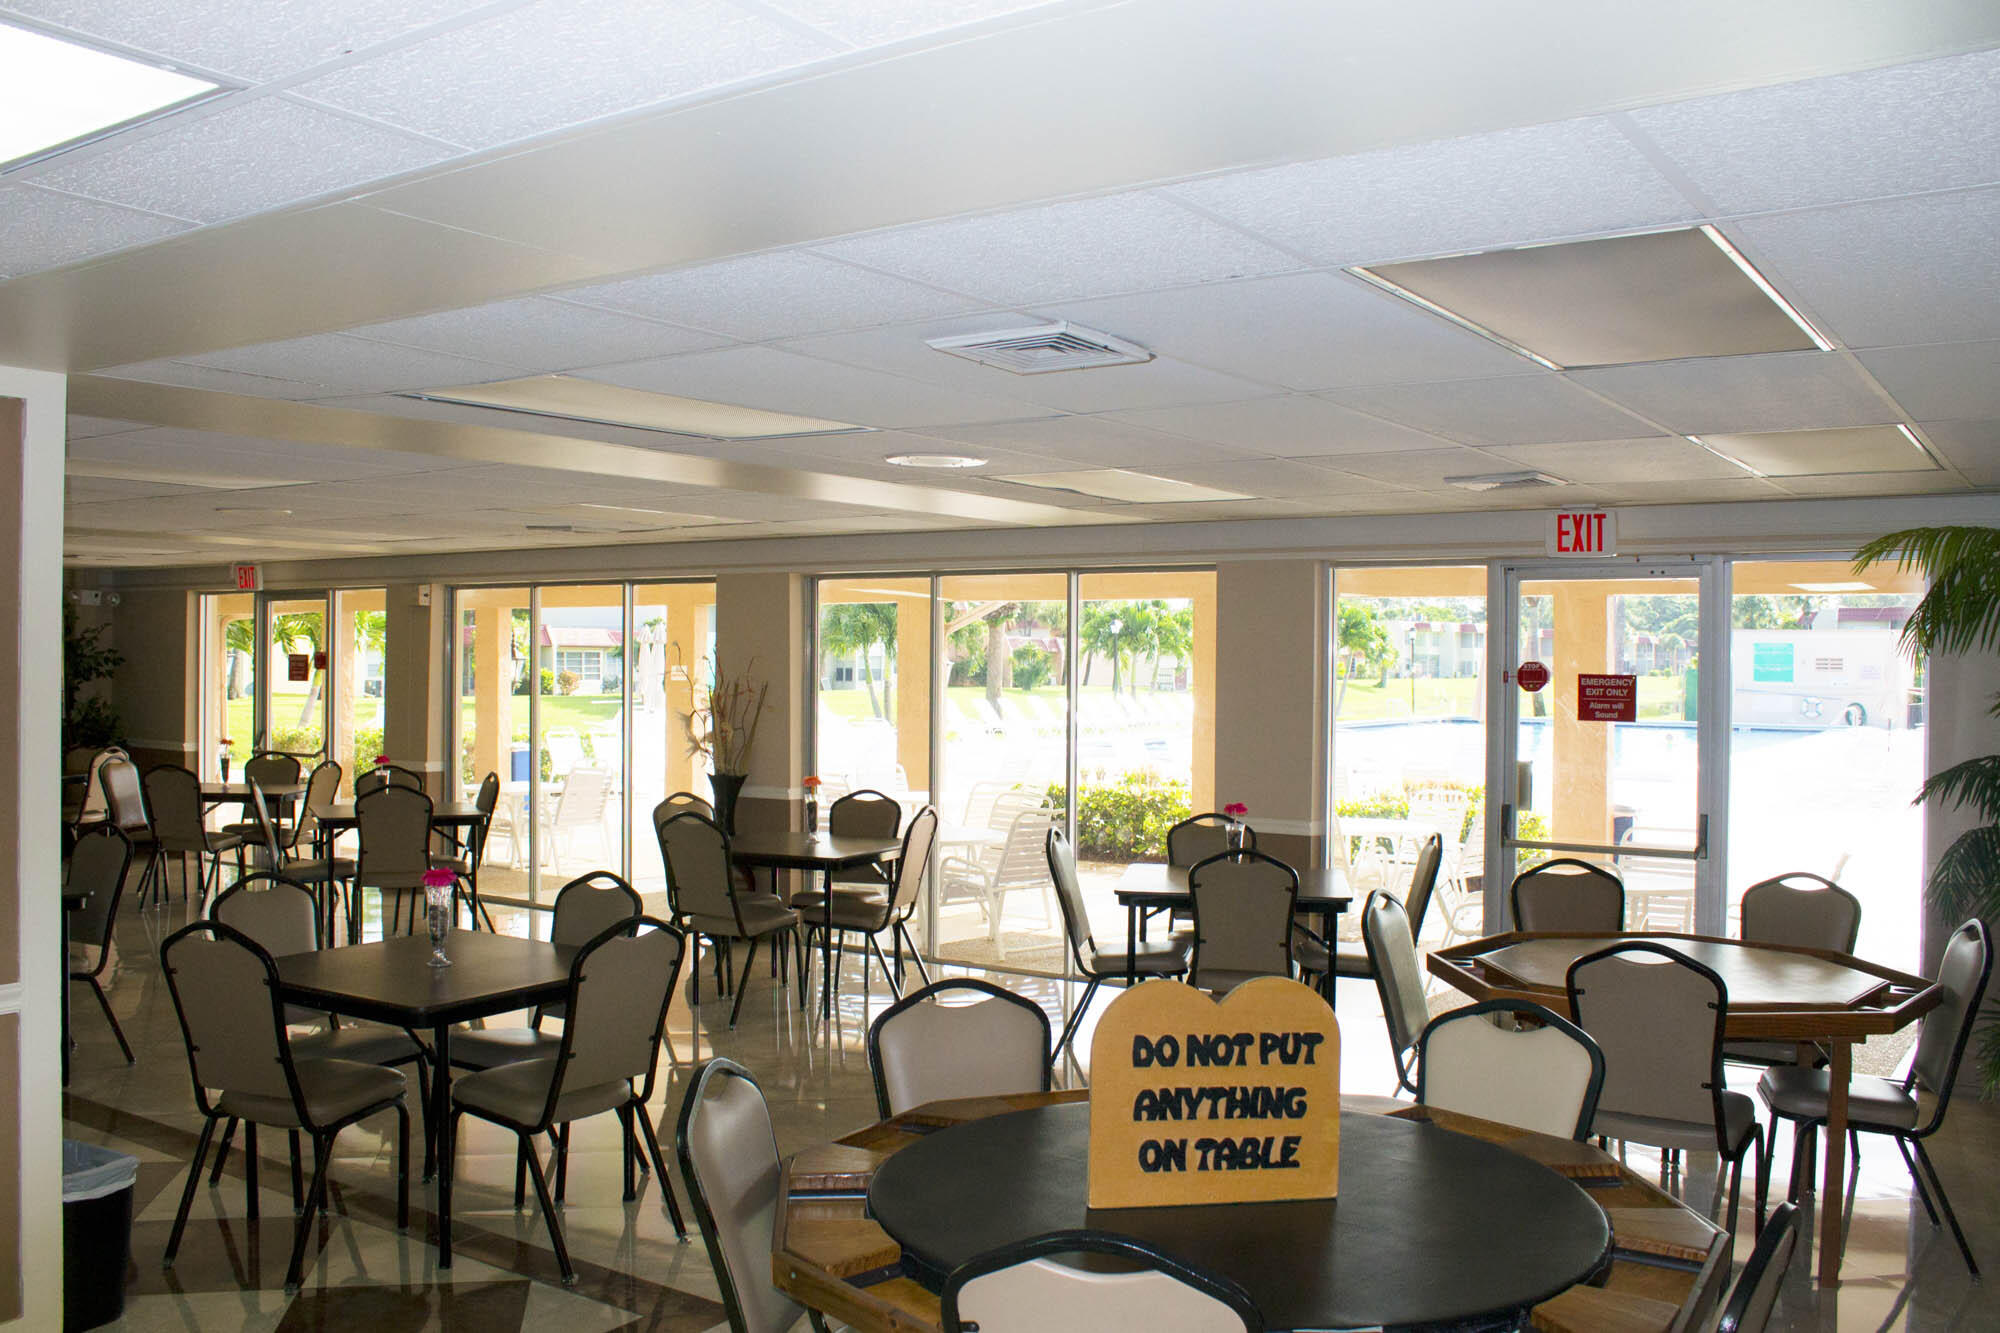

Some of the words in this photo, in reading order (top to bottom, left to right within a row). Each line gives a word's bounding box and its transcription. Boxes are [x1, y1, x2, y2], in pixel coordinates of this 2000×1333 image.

[1557, 513, 1607, 553] EXIT
[238, 566, 255, 589] EXIT
[1581, 677, 1633, 687] EMERGENCY
[1586, 688, 1604, 696] EXIT
[1606, 688, 1628, 697] ONLY
[1589, 701, 1611, 710] Alarm
[1612, 702, 1625, 710] will
[1594, 710, 1619, 719] Sound
[1132, 1034, 1180, 1068] DO
[1186, 1033, 1255, 1067] NOT
[1260, 1032, 1325, 1065] PUT
[1133, 1086, 1308, 1122] ANYTHING
[1138, 1138, 1188, 1172] ON
[1194, 1135, 1302, 1171] TABLE
